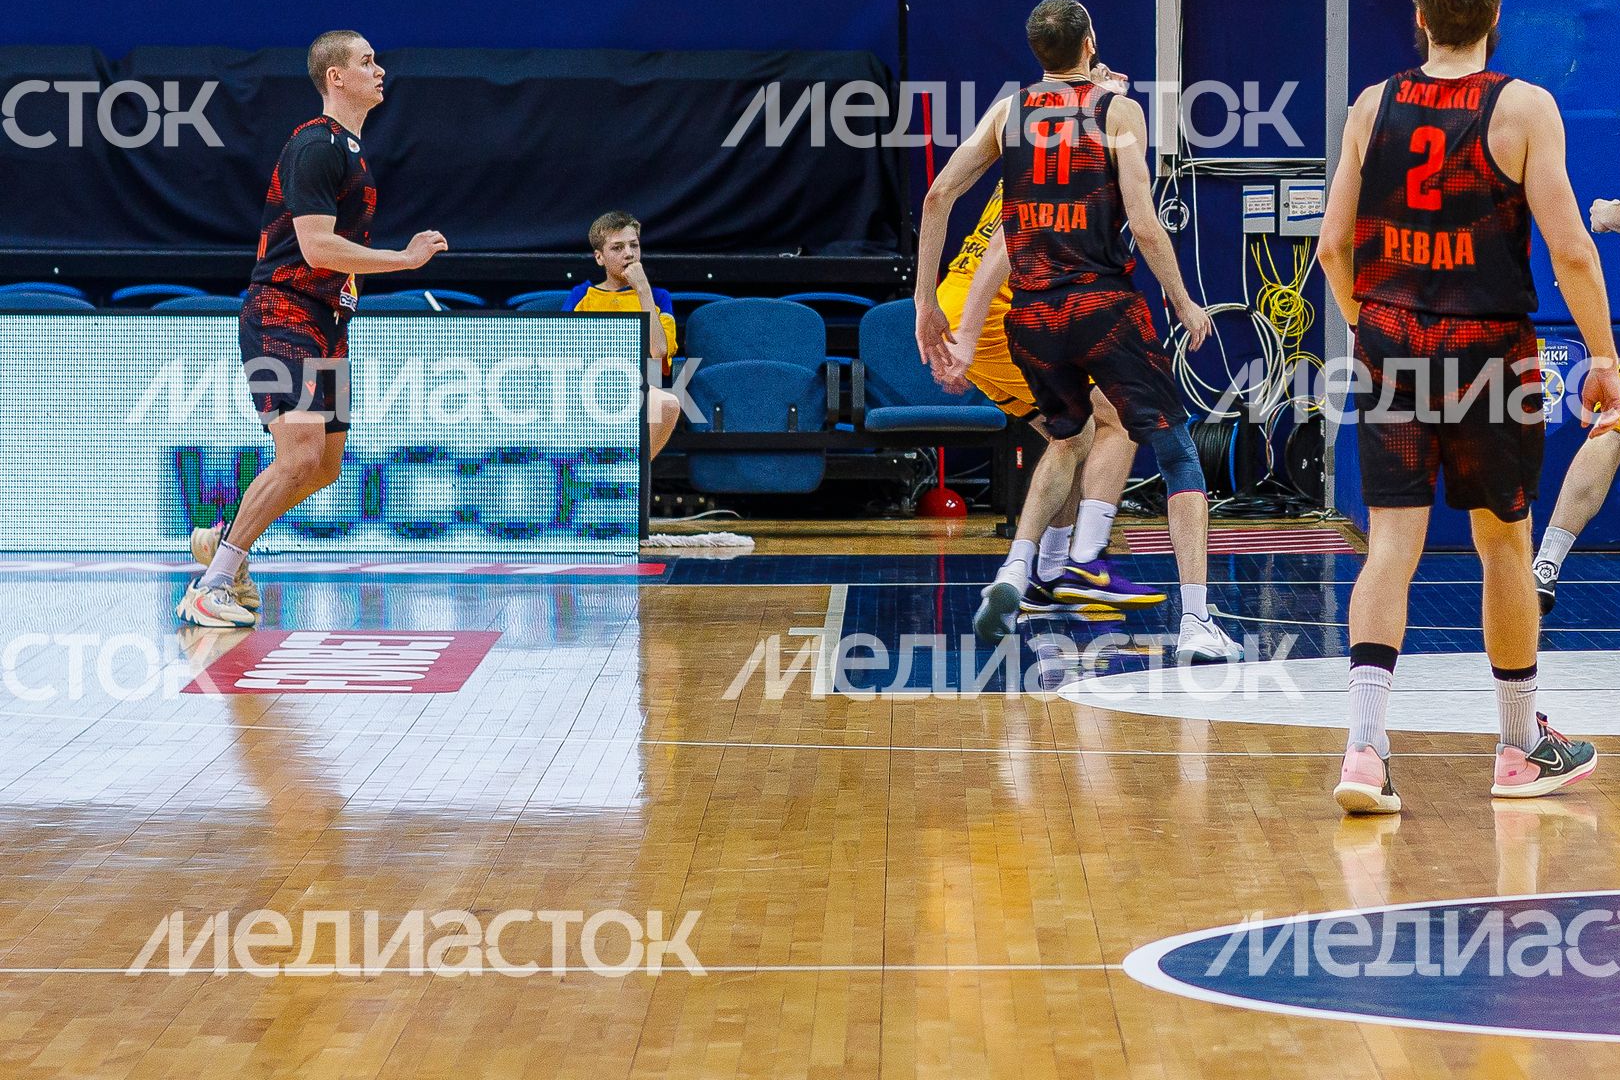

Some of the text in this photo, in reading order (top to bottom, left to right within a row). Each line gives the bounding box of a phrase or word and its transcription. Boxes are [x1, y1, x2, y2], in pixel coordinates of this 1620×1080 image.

[1030, 121, 1074, 184] 11
[1406, 125, 1446, 210] 2
[1017, 203, 1088, 232] РЕВДА
[1384, 225, 1475, 270] РЕВДА
[233, 631, 456, 691] FONBET
